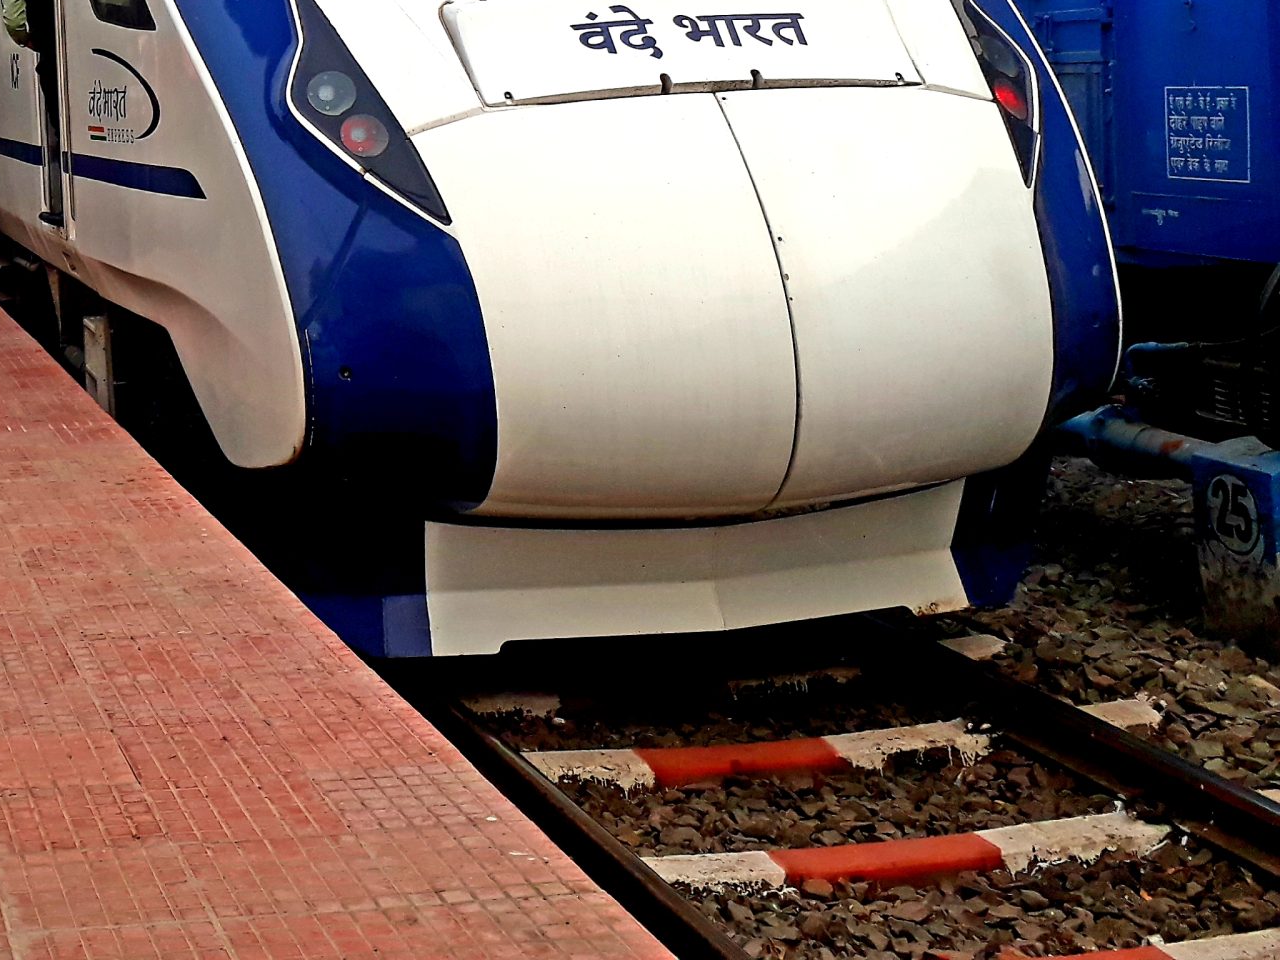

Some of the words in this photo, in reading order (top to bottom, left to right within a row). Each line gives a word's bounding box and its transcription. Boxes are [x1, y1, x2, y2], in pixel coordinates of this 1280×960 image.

[570, 5, 663, 59] वंदे
[672, 12, 808, 48] भारत
[107, 128, 135, 143] EXPRESS
[1212, 478, 1252, 543] 25
